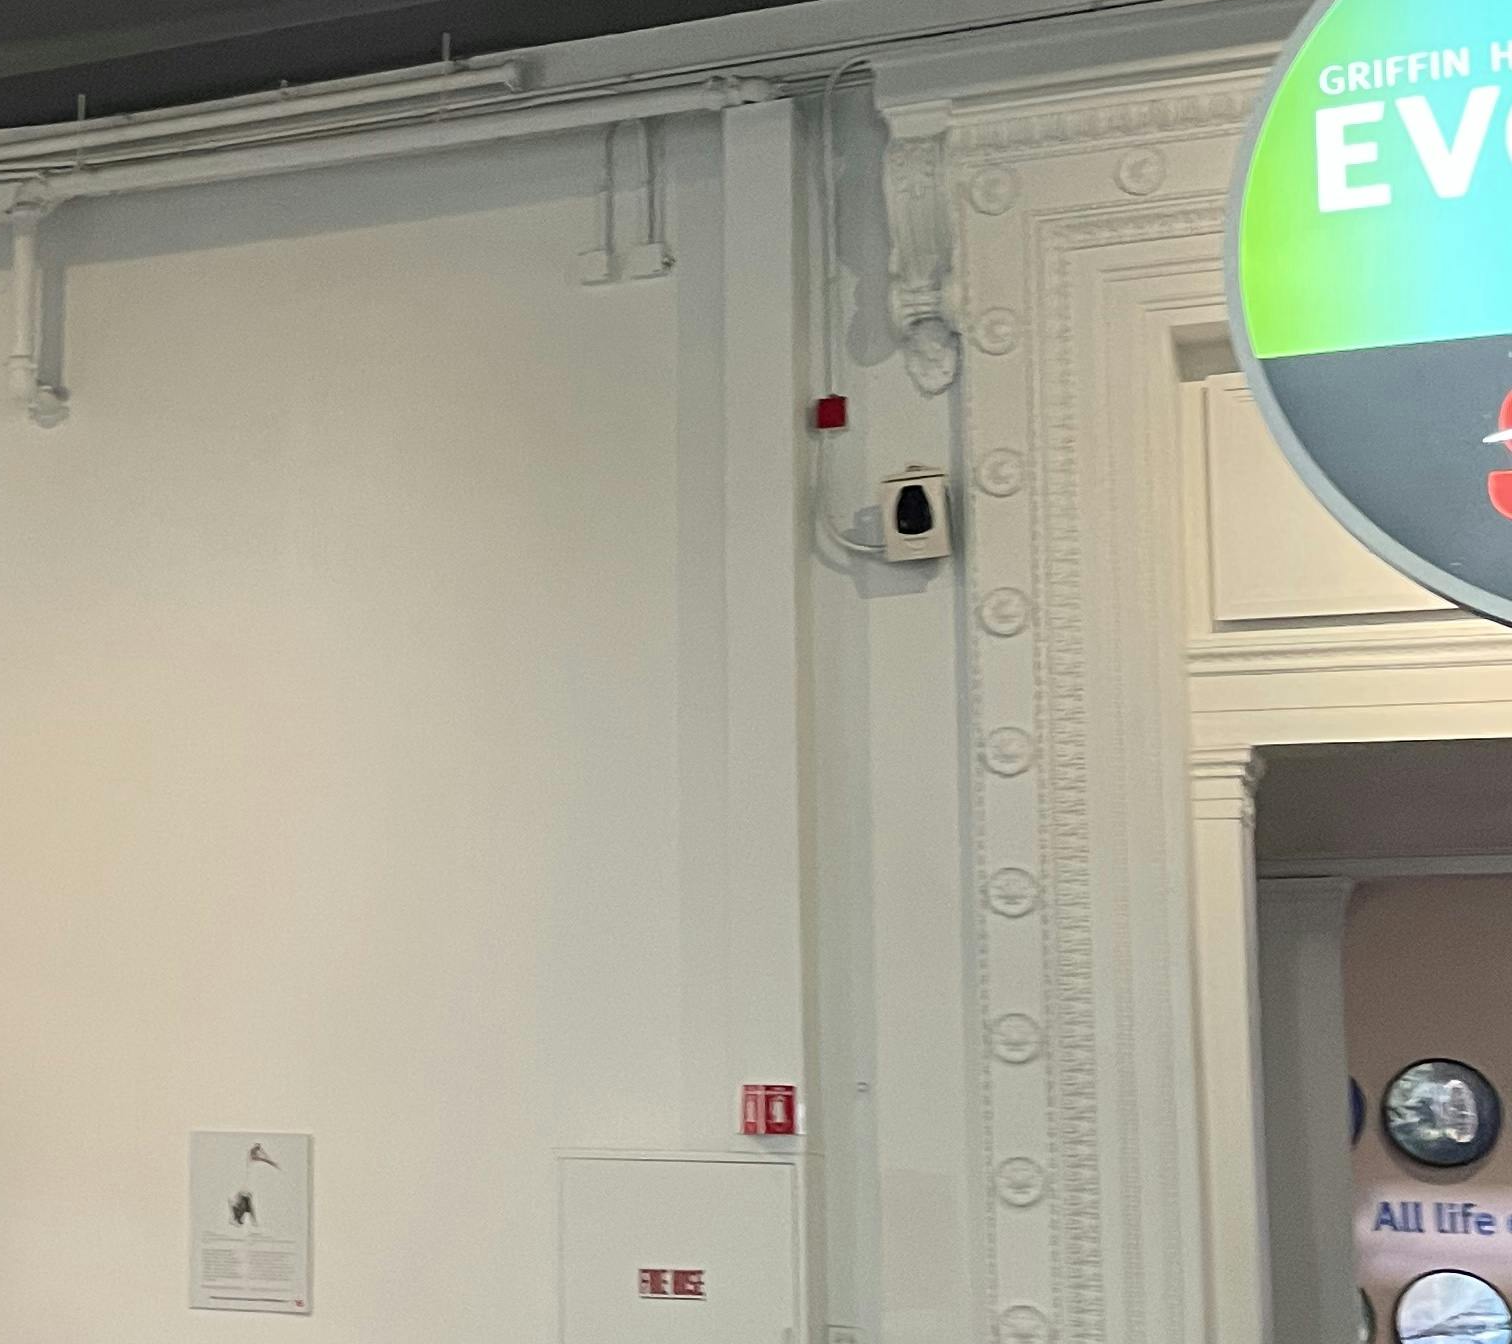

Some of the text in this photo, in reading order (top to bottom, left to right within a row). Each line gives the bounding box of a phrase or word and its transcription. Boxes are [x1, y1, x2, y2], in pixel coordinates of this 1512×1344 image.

[1319, 46, 1471, 96] GRIFFIN
[1315, 84, 1512, 214] EV
[1371, 1200, 1426, 1233] All
[1433, 1201, 1496, 1236] life
